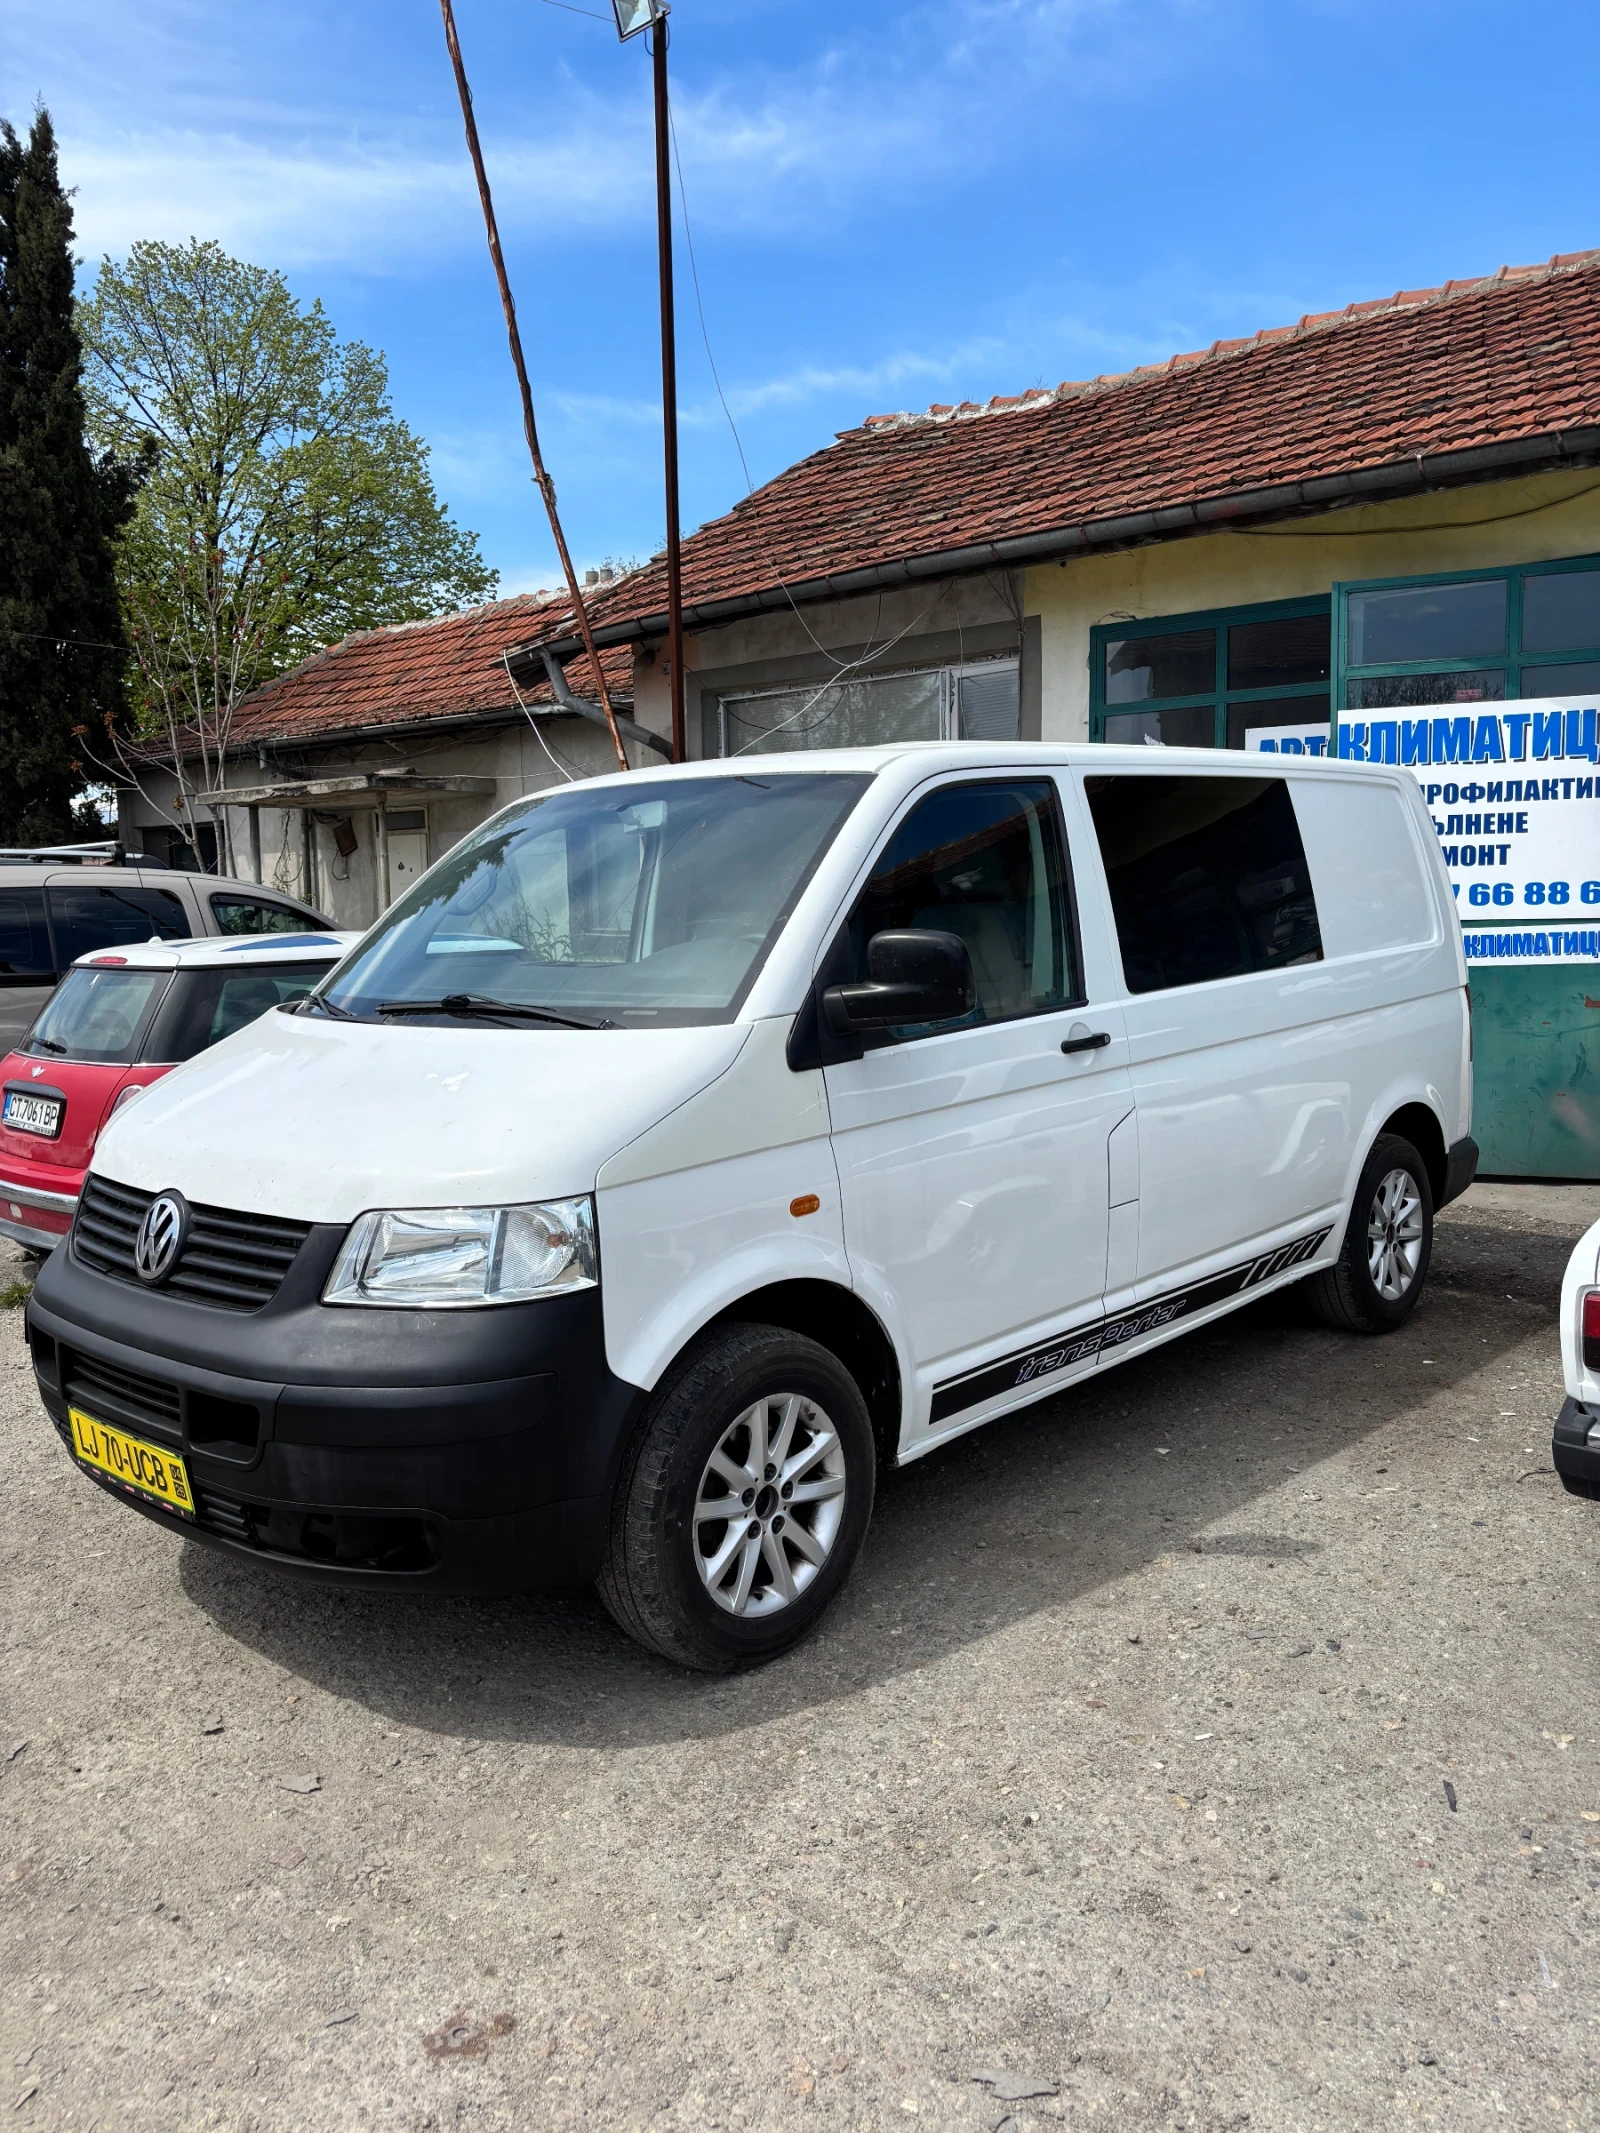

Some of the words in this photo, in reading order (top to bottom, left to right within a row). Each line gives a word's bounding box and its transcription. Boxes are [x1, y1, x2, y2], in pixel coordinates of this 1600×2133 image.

[1468, 883, 1514, 906] 66
[1524, 881, 1570, 905] 88
[1463, 930, 1600, 958] КЛИМАТИЦ
